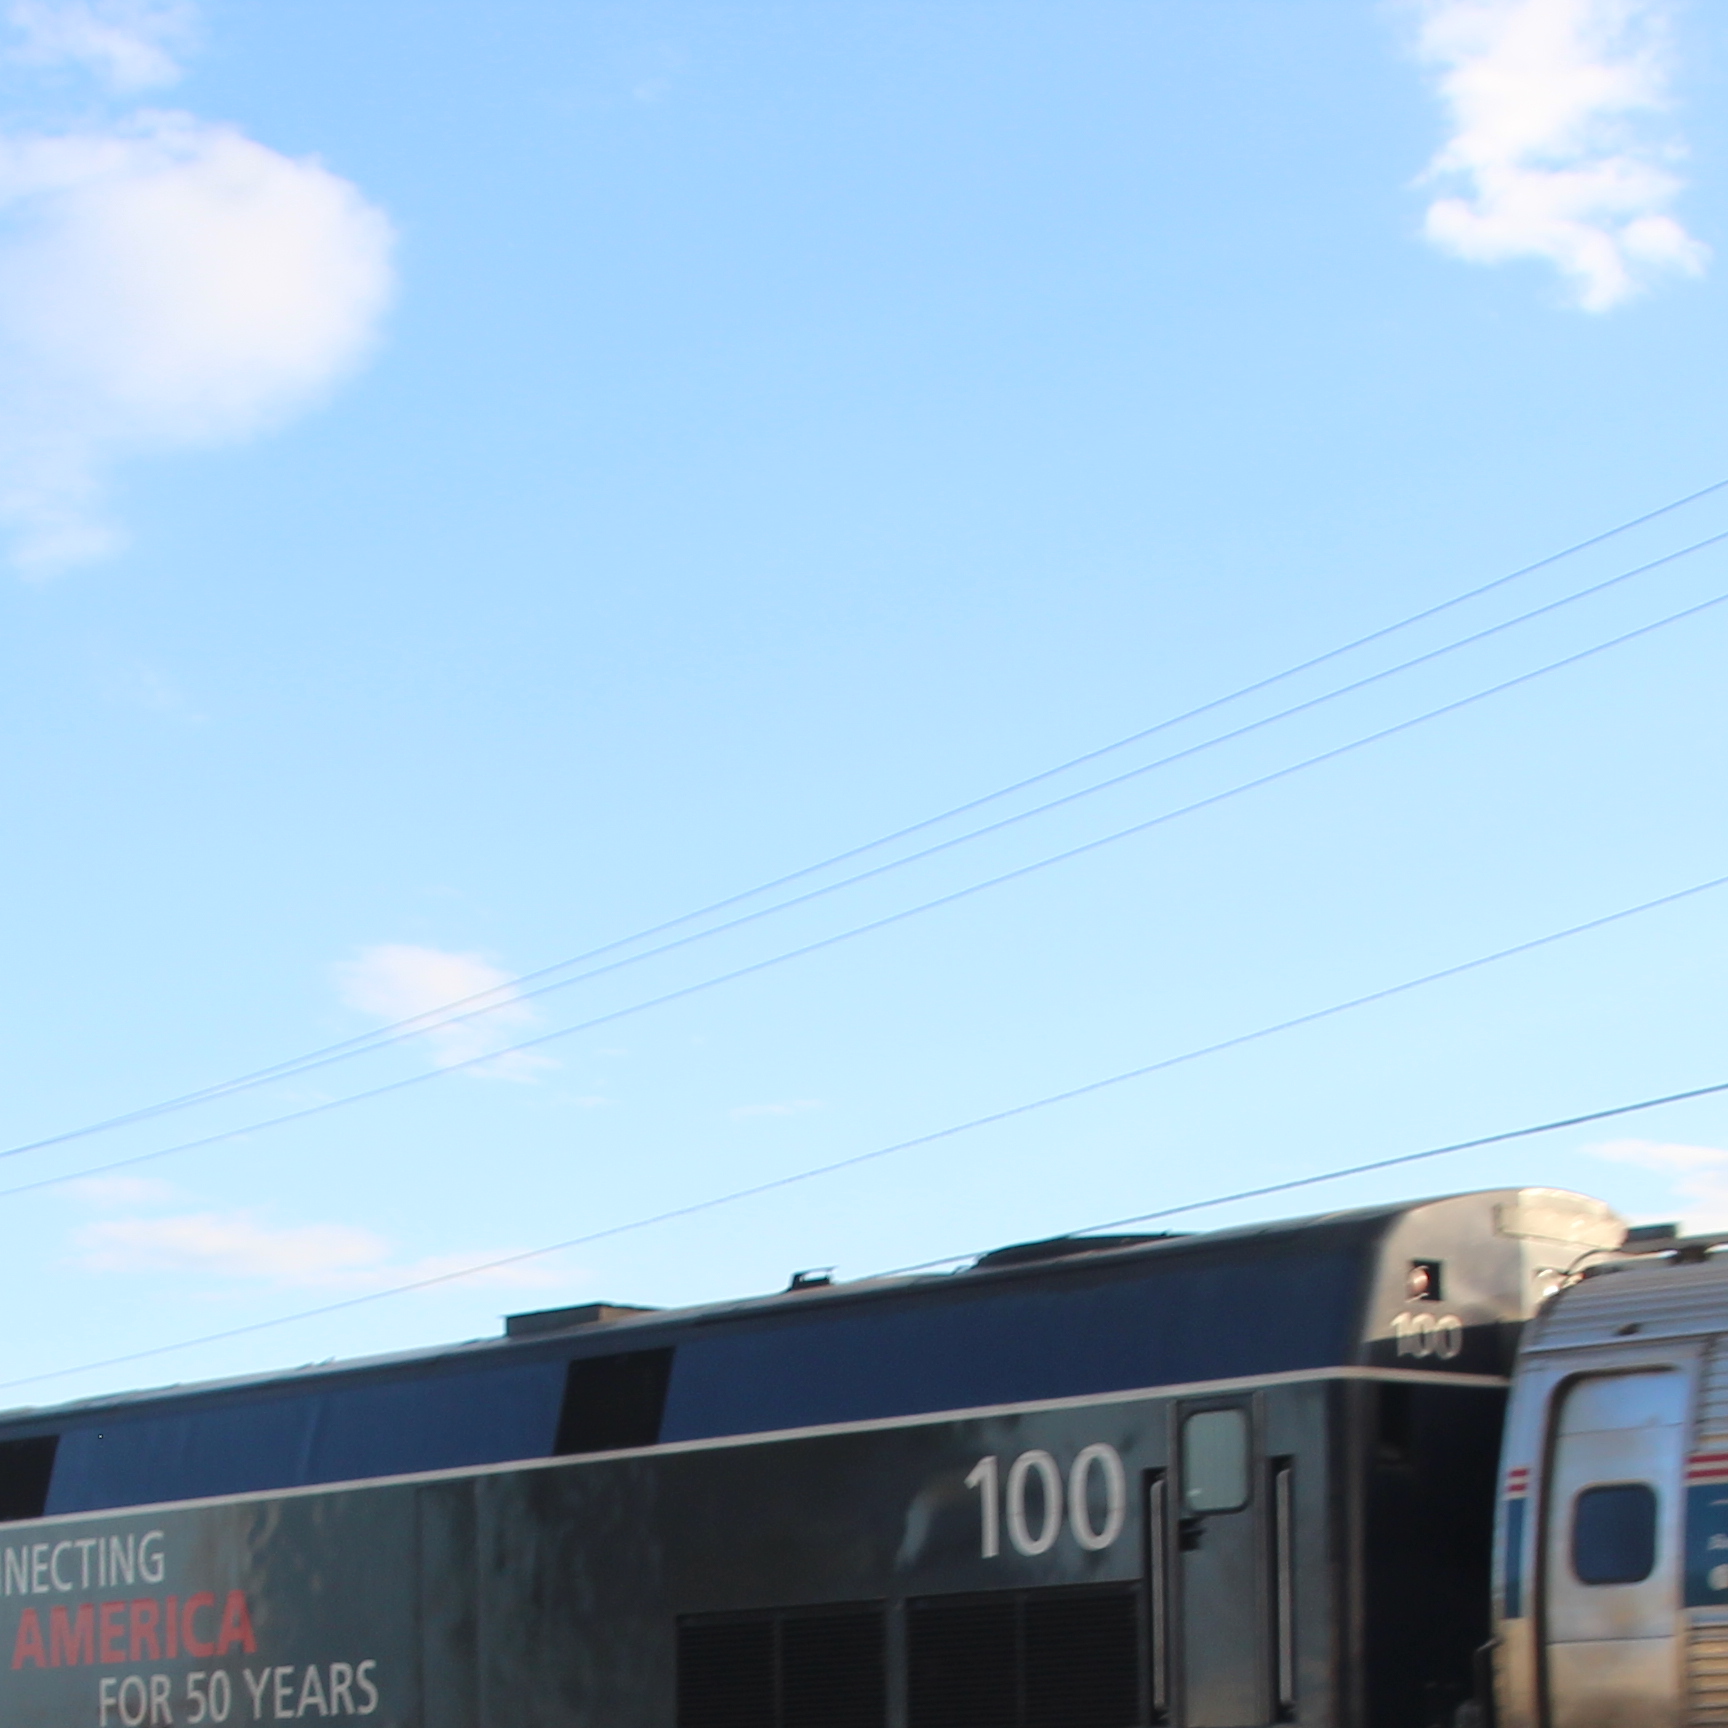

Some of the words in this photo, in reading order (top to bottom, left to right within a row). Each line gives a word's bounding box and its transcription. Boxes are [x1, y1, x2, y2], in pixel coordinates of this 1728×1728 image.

[1390, 1311, 1462, 1359] 100
[963, 1442, 1126, 1559] 100
[11, 1589, 258, 1670] AMERICA
[99, 1674, 172, 1728] FOR
[186, 1669, 231, 1724] 50
[243, 1659, 379, 1721] YEARS
